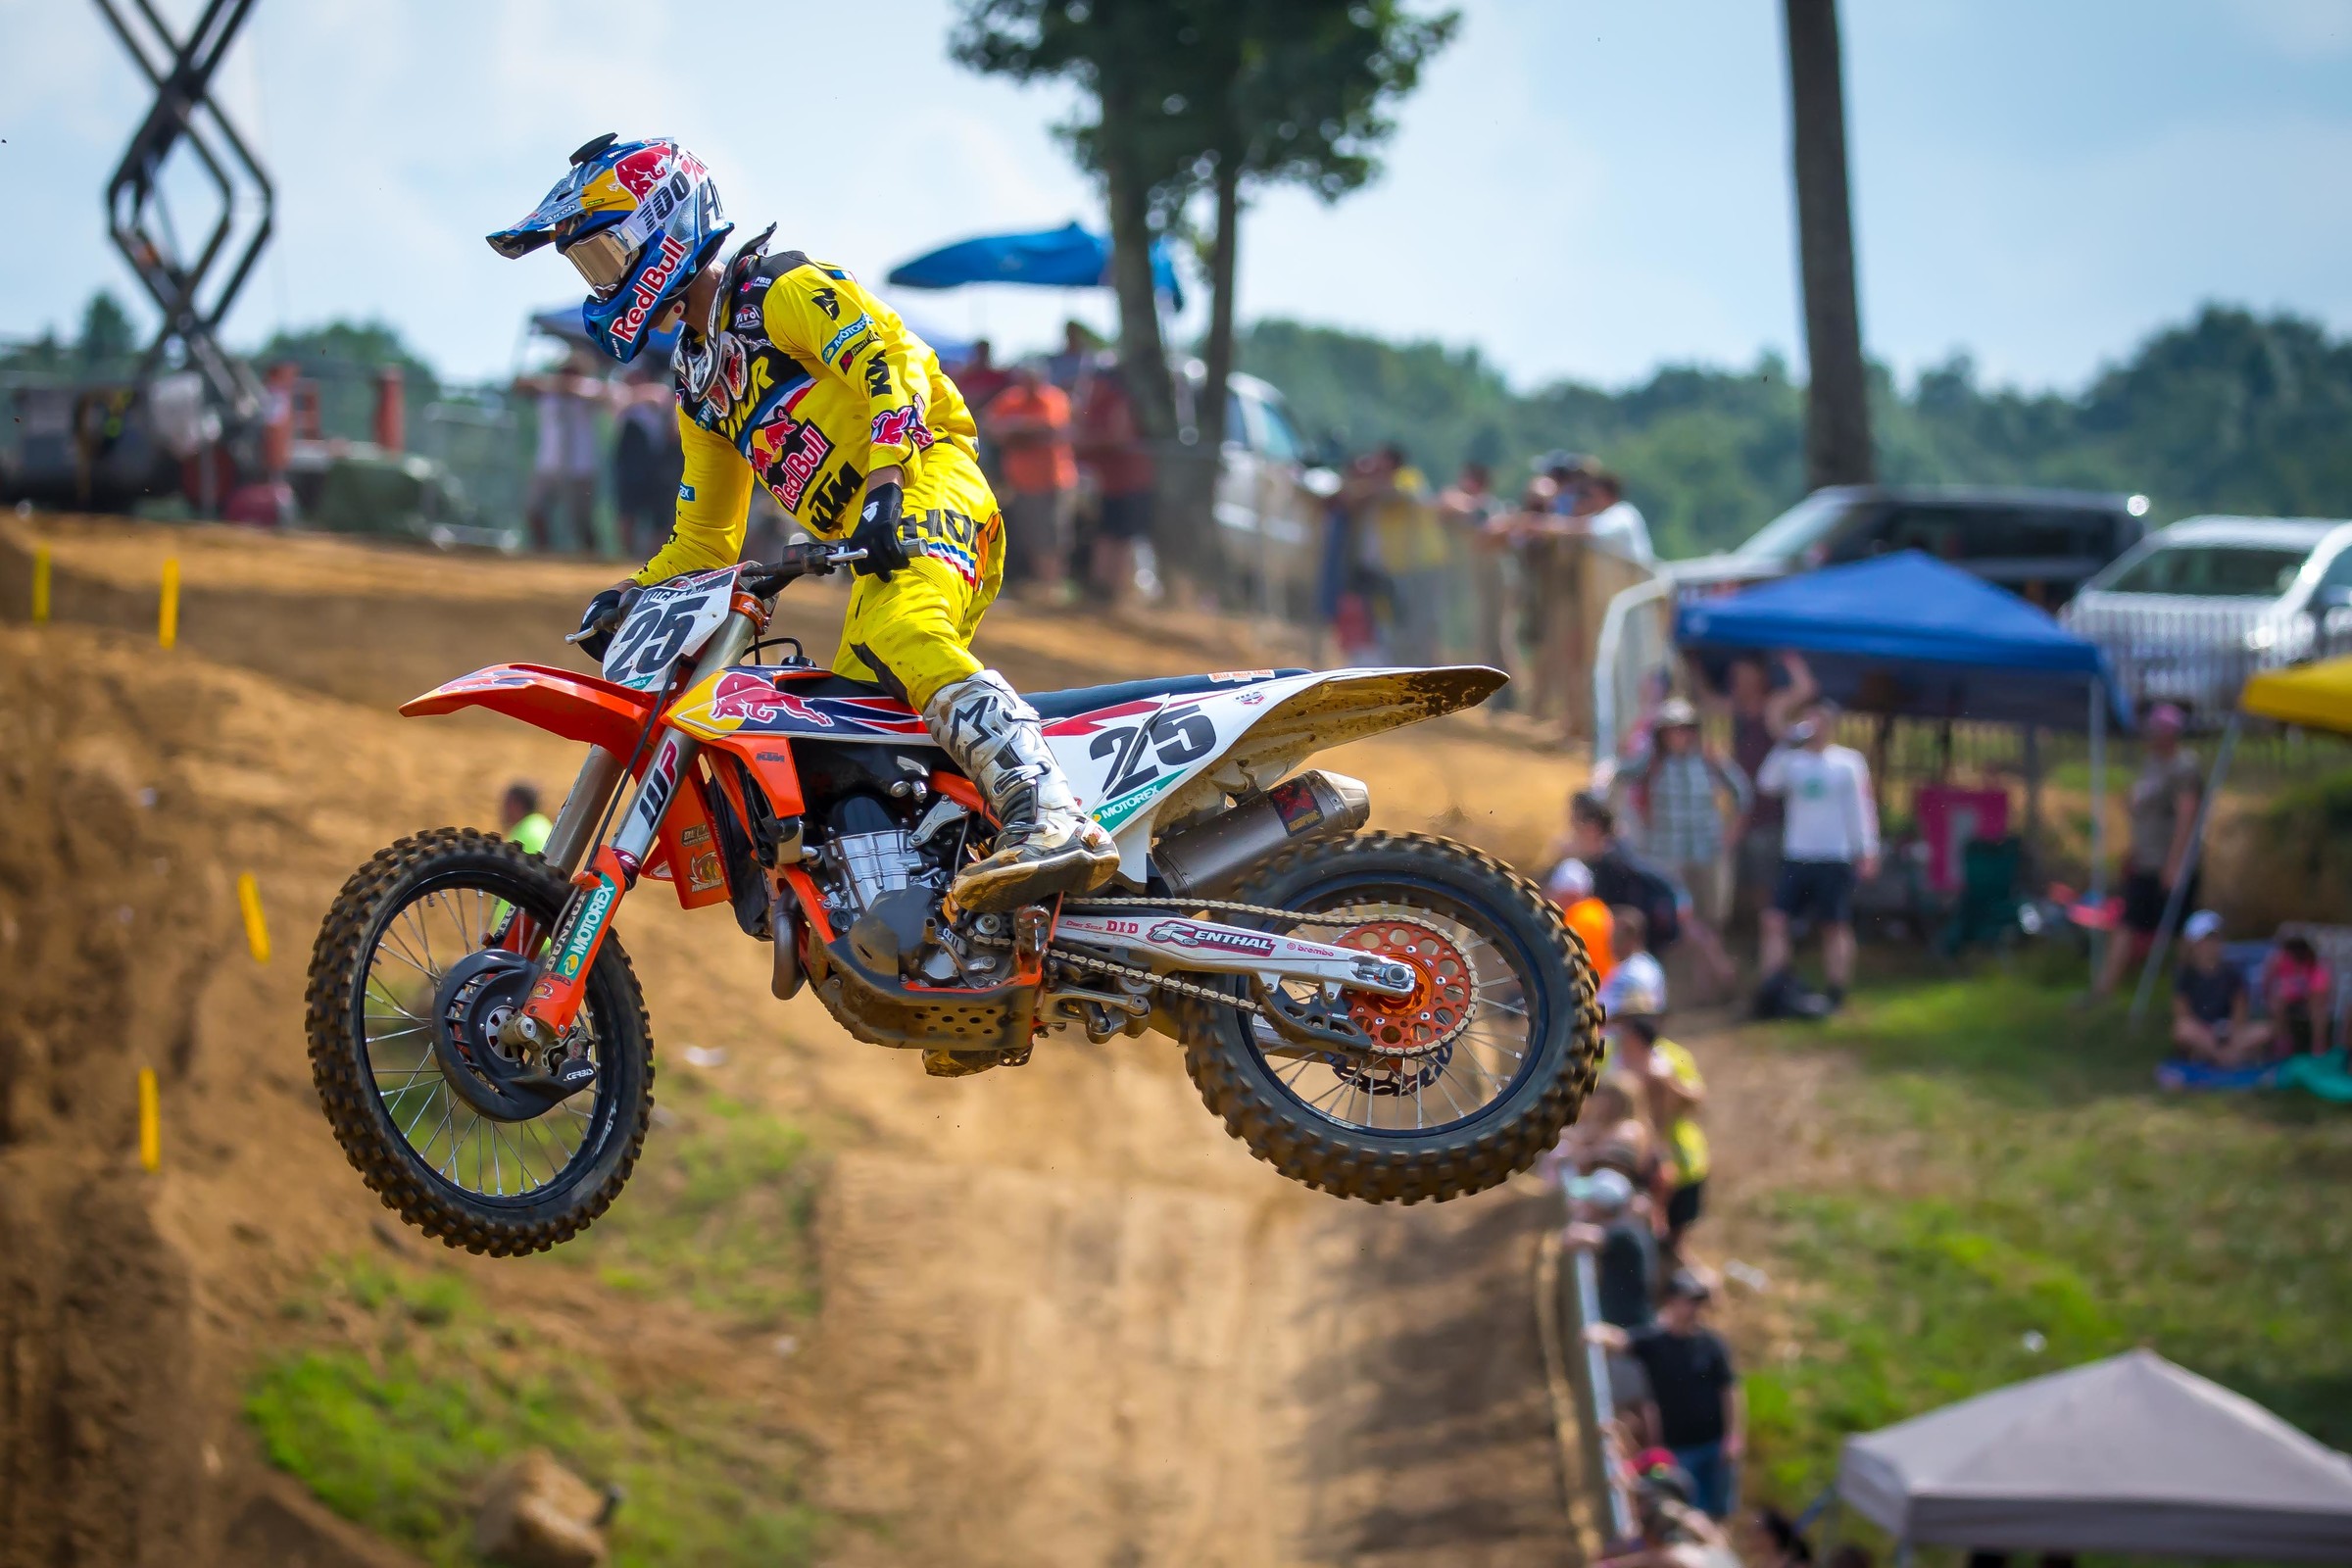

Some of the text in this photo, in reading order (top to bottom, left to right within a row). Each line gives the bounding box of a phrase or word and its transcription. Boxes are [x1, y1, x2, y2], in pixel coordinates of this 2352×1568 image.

[545, 204, 576, 222] Airoh
[771, 423, 830, 512] Red Bull
[807, 461, 865, 534] KTM
[604, 595, 711, 684] 25
[756, 752, 785, 762] KTM
[1089, 704, 1217, 802] 25
[1101, 785, 1161, 820] MOTOREX
[569, 882, 615, 956] MOTOREX
[1105, 919, 1139, 934] DID
[1152, 922, 1272, 950] RENTHAL
[1298, 944, 1335, 957] brembo
